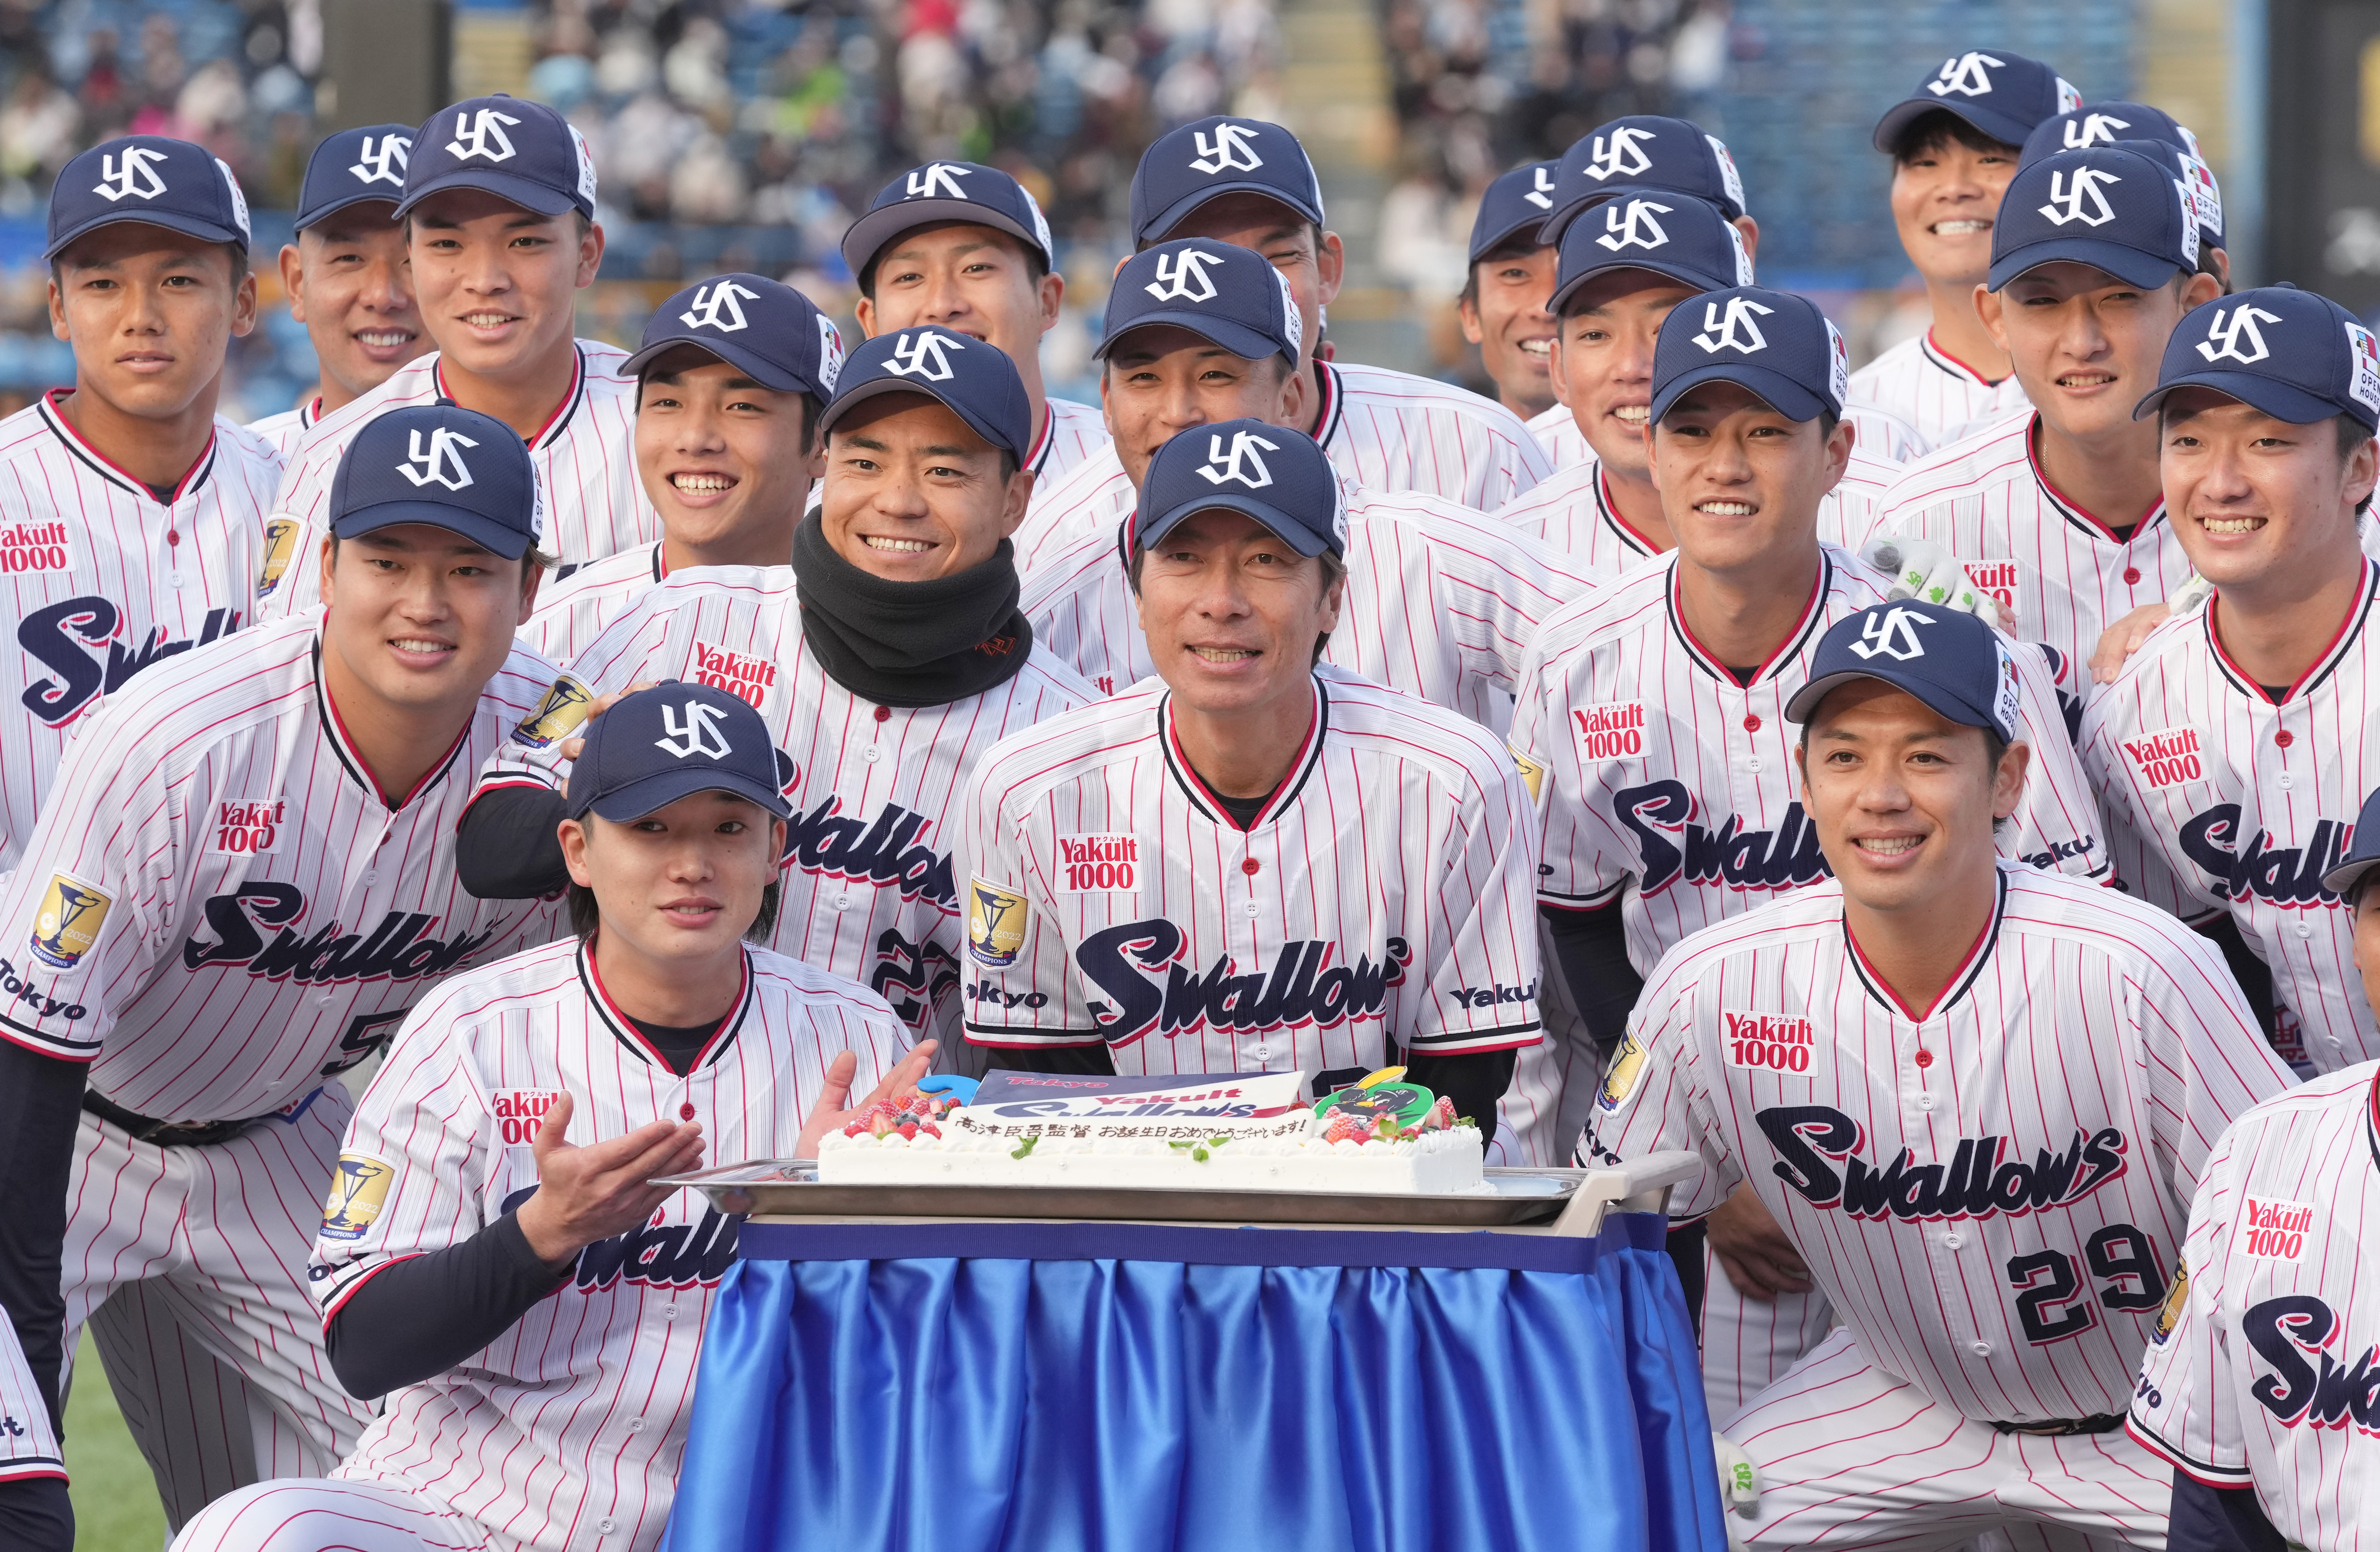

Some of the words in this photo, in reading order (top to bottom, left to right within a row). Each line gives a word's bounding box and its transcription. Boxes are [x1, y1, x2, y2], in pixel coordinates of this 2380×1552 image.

[1928, 52, 2006, 96] YS
[445, 108, 521, 162] YS
[1188, 123, 1263, 174] YS
[1583, 126, 1656, 180] YS
[92, 146, 168, 202] YS
[2038, 166, 2122, 226] YS
[2197, 197, 2219, 217] OPEN
[1596, 199, 1674, 252] YS
[1144, 248, 1224, 302] YS
[679, 280, 760, 332] YS
[1692, 297, 1774, 354] YS
[2196, 304, 2282, 364] YS
[881, 331, 965, 381] YS
[396, 427, 479, 490] YS
[1196, 430, 1280, 488] YS
[0, 522, 68, 547] akult
[269, 558, 286, 568] 2022
[1964, 563, 2018, 588] kult
[1848, 606, 1936, 660] YS
[696, 642, 776, 686] Yakult
[737, 654, 758, 664] ヤクルト
[1574, 704, 1644, 734] Yakult
[1604, 704, 1627, 712] ヤクルト
[512, 731, 538, 748] CHAMPIONS
[546, 716, 568, 734] 2022
[654, 700, 732, 760] YS
[2160, 730, 2180, 739] ヤクルト
[1584, 729, 1641, 759] 1000
[2124, 728, 2200, 764] Yakult
[2142, 754, 2201, 788] 1000
[1060, 836, 1138, 863] Yakult
[1614, 780, 1835, 900] Swall
[1066, 862, 1134, 890] 1000
[66, 928, 92, 944] 2022
[996, 930, 1022, 941] 2022
[32, 946, 68, 966] CHAMPIONS
[971, 949, 1007, 964] CHAMPIONS
[0, 958, 86, 1020] Tokyo
[1449, 978, 1536, 1009] Yaku
[1725, 1012, 1814, 1046] Yakult
[1731, 1040, 1809, 1072] 1000
[1006, 1076, 1109, 1088] Tokyo
[1094, 1088, 1243, 1105] Yakult
[1612, 1072, 1630, 1092] 2022
[955, 1116, 1092, 1138] 高津臣吾監督
[1754, 1106, 2128, 1224] Swallows
[352, 1200, 378, 1214] 2022
[2248, 1198, 2312, 1232] Yakult
[2280, 1204, 2302, 1212] ヤクルト
[320, 1228, 357, 1238] CHAMPIONS
[2246, 1228, 2302, 1259] 1000
[2006, 1224, 2170, 1348] 29
[2168, 1303, 2178, 1321] 2022
